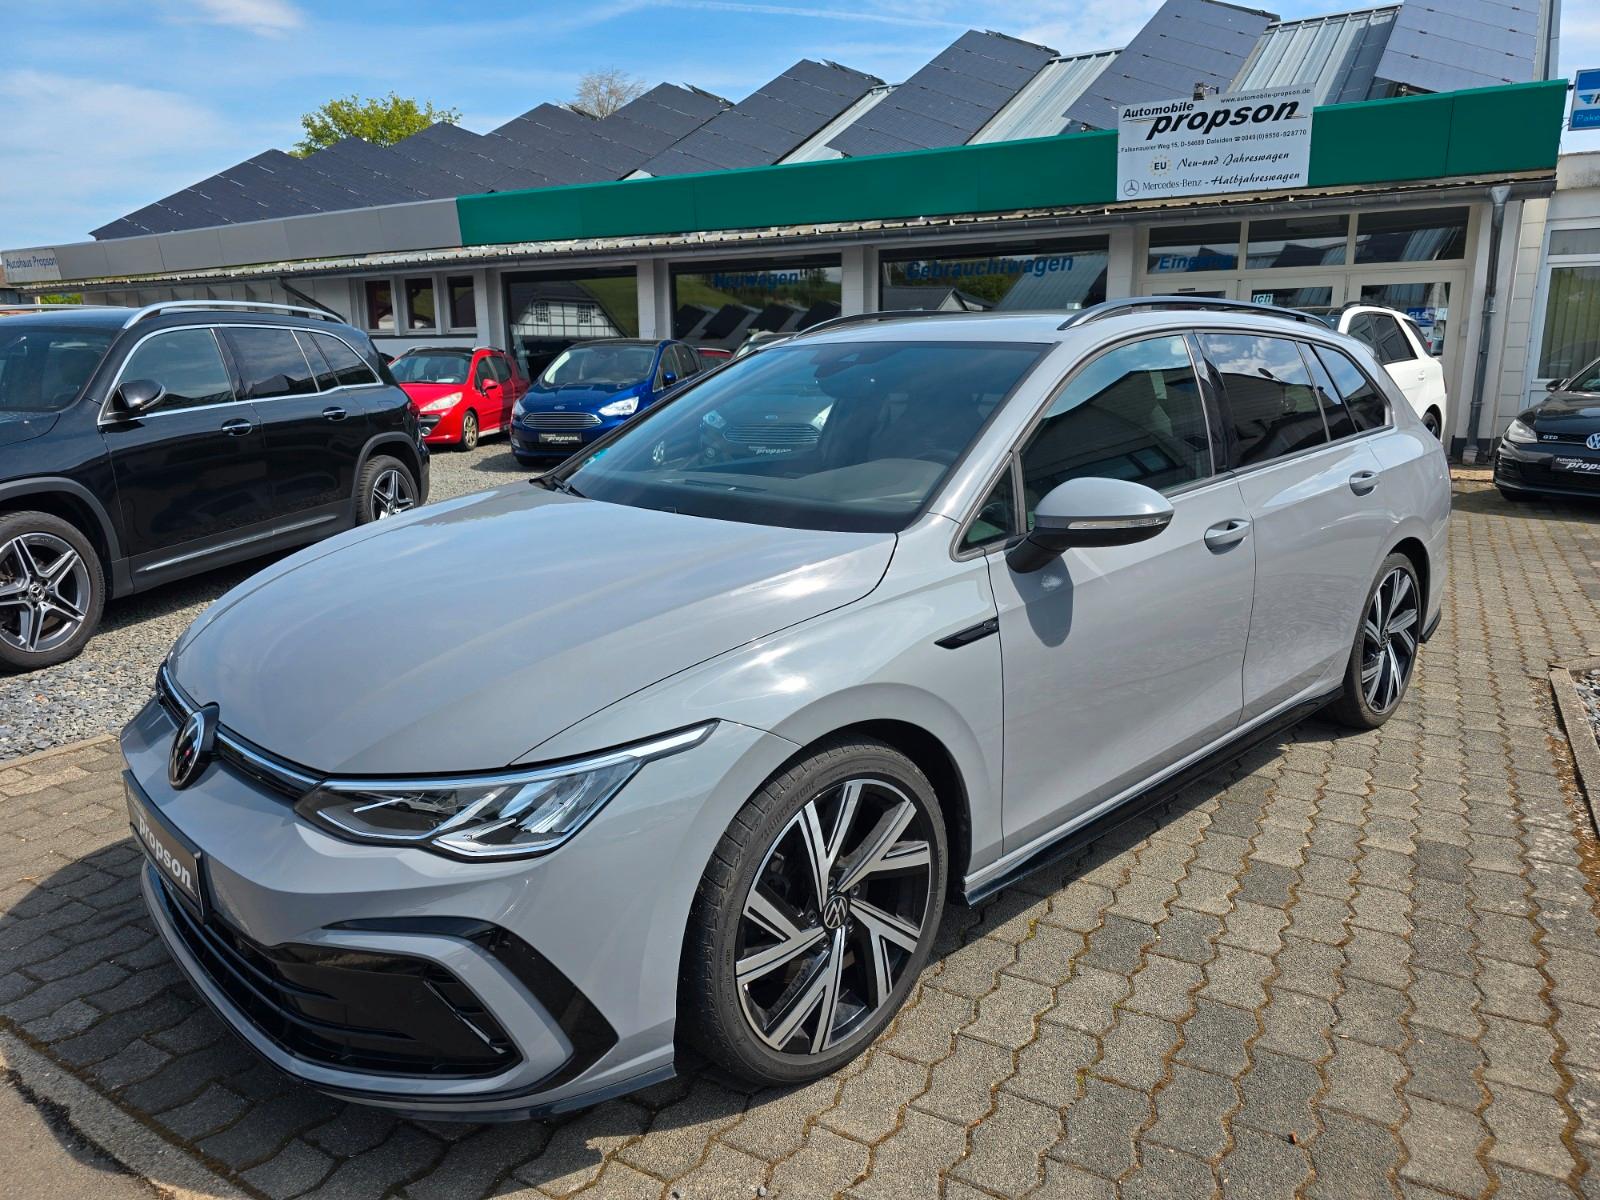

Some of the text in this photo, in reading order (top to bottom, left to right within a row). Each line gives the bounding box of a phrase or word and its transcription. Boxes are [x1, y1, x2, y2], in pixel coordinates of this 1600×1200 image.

[1122, 101, 1194, 119] Automobile
[1145, 100, 1300, 141] propson
[1158, 143, 1170, 151] Weg
[1154, 161, 1167, 171] EU
[1222, 153, 1290, 167] Jahreswagen
[1142, 178, 1202, 191] Mercedes-Benz
[1210, 172, 1300, 187] Halbjahreswagen
[906, 255, 1074, 280] Gebrauchtwagen
[1159, 254, 1233, 272] Eing
[139, 815, 191, 889] propson
